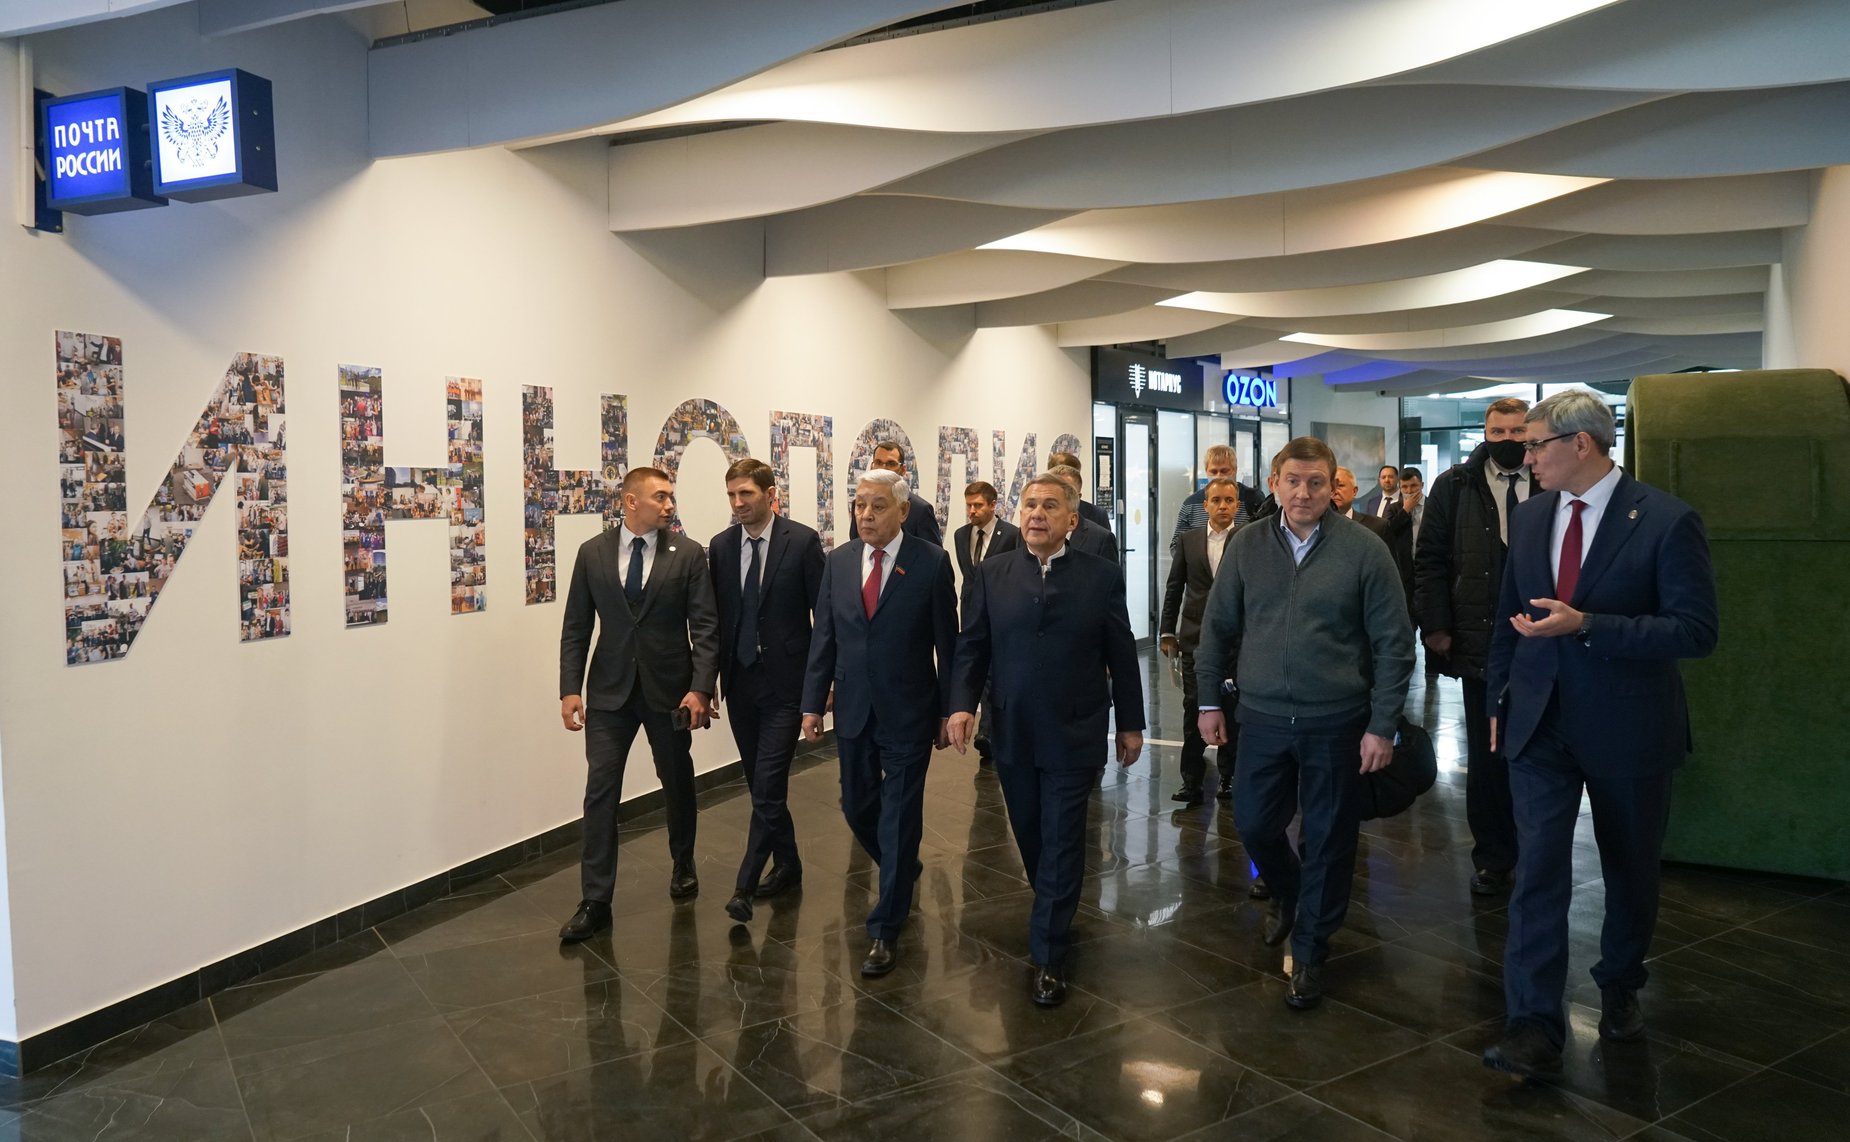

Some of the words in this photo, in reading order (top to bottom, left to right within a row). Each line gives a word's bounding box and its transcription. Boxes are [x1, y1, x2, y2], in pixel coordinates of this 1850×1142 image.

[54, 117, 120, 148] ПОЧТА
[56, 147, 122, 178] РОССИИ
[1148, 370, 1181, 394] НОТАРИУС
[1226, 373, 1277, 407] OZON
